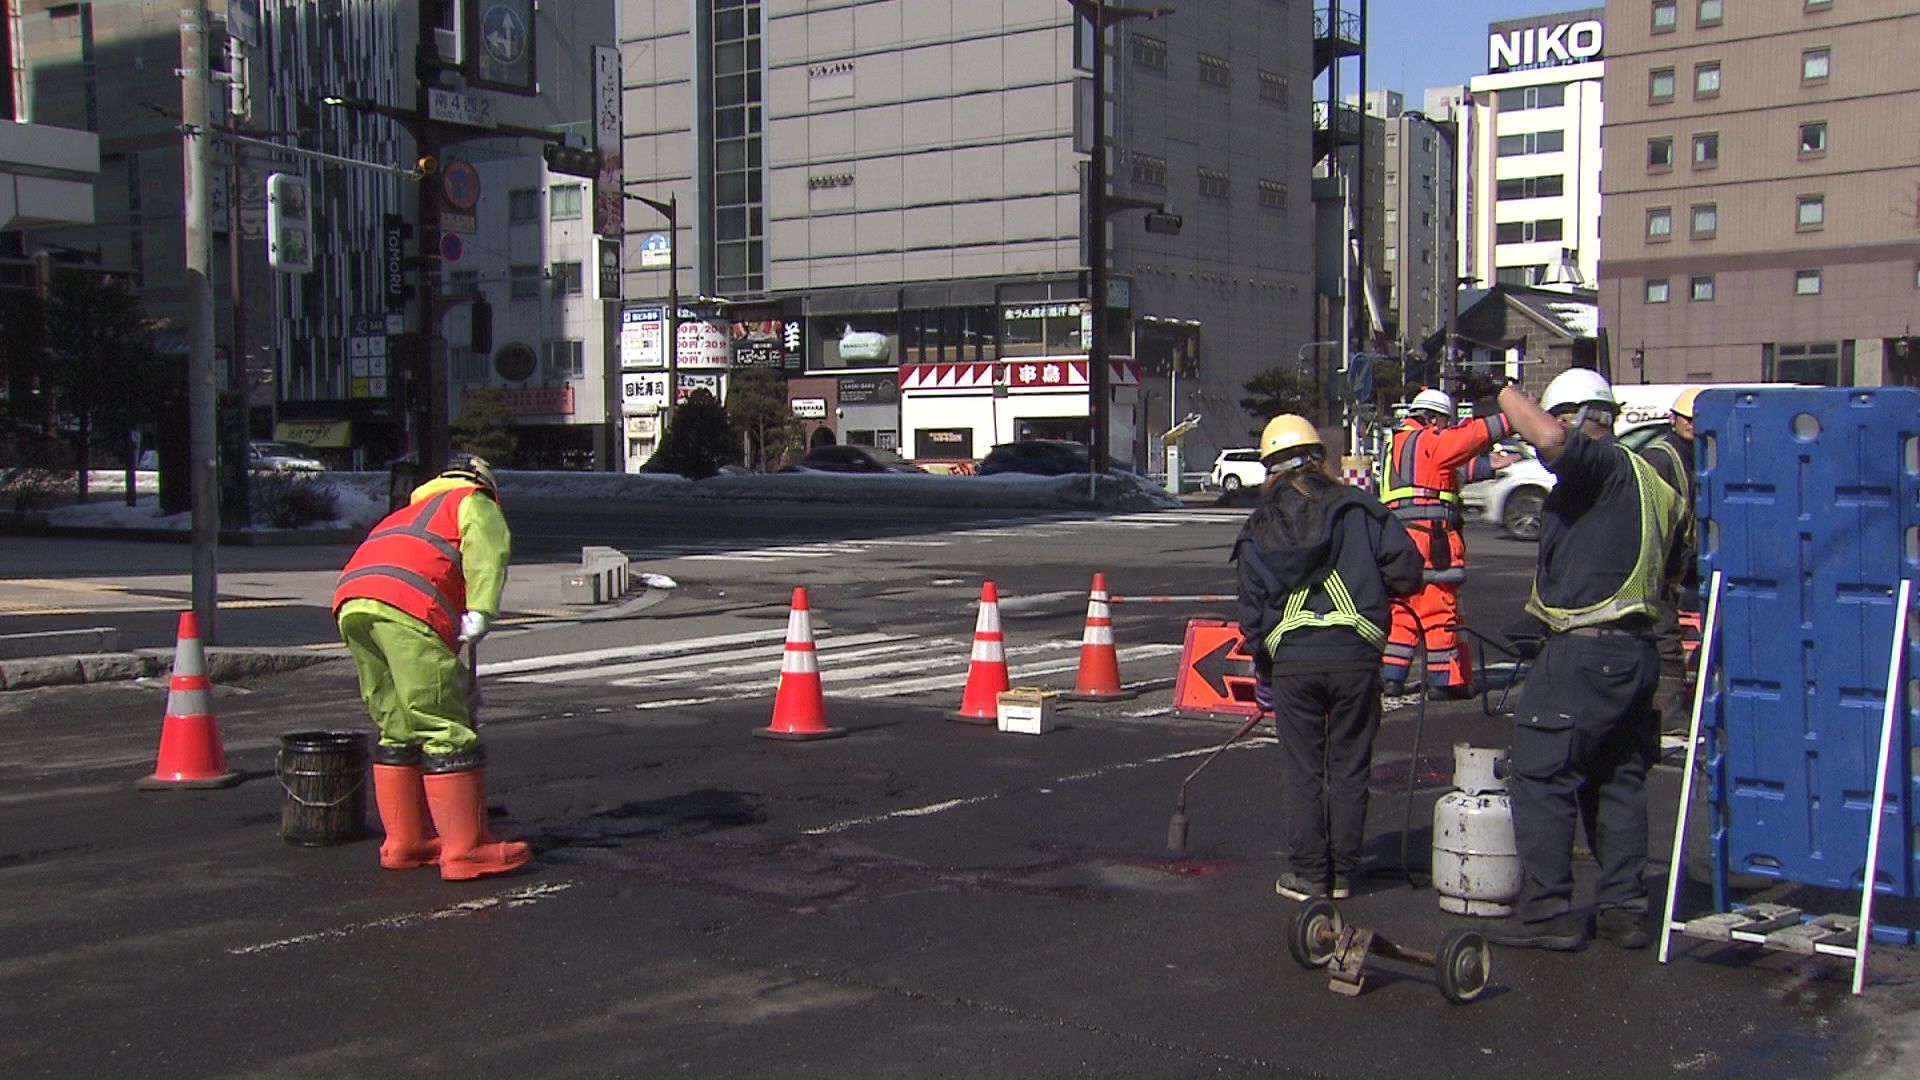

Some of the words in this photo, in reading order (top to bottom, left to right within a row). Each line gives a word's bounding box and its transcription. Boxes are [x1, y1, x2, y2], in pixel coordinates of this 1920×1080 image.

[1489, 20, 1602, 69] NIKO
[1018, 363, 1061, 384] 串鳥
[625, 381, 664, 397] 回転寿司
